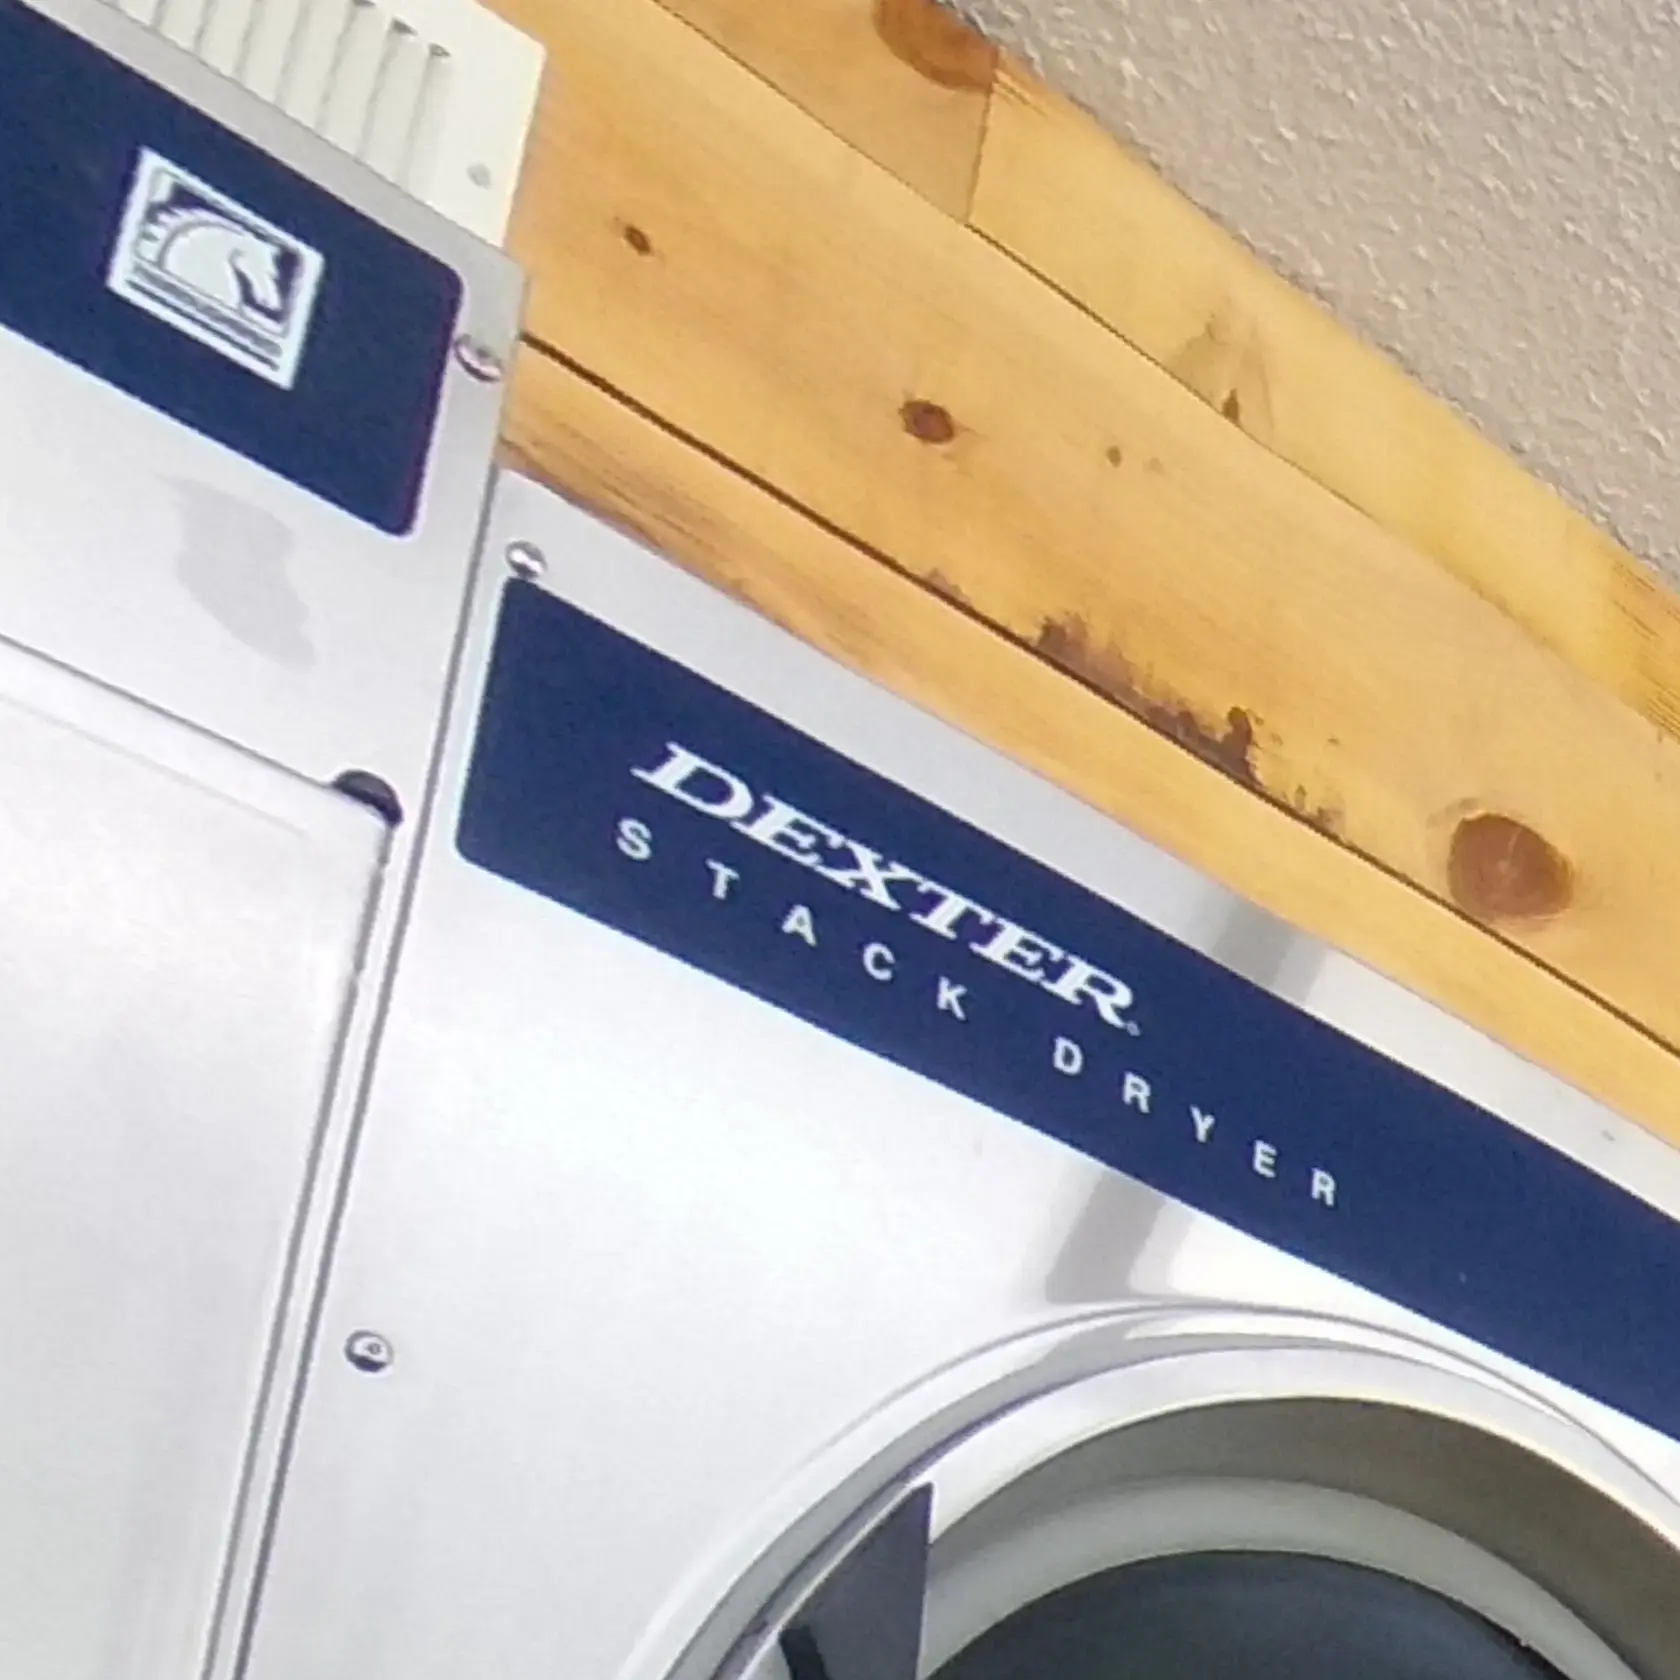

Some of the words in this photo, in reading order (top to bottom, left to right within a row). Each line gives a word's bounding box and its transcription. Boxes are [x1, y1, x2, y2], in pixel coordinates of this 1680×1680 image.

[617, 818, 965, 1021] STACK
[1054, 1037, 1337, 1206] DRYER
[633, 742, 1140, 1031] DEXTER
